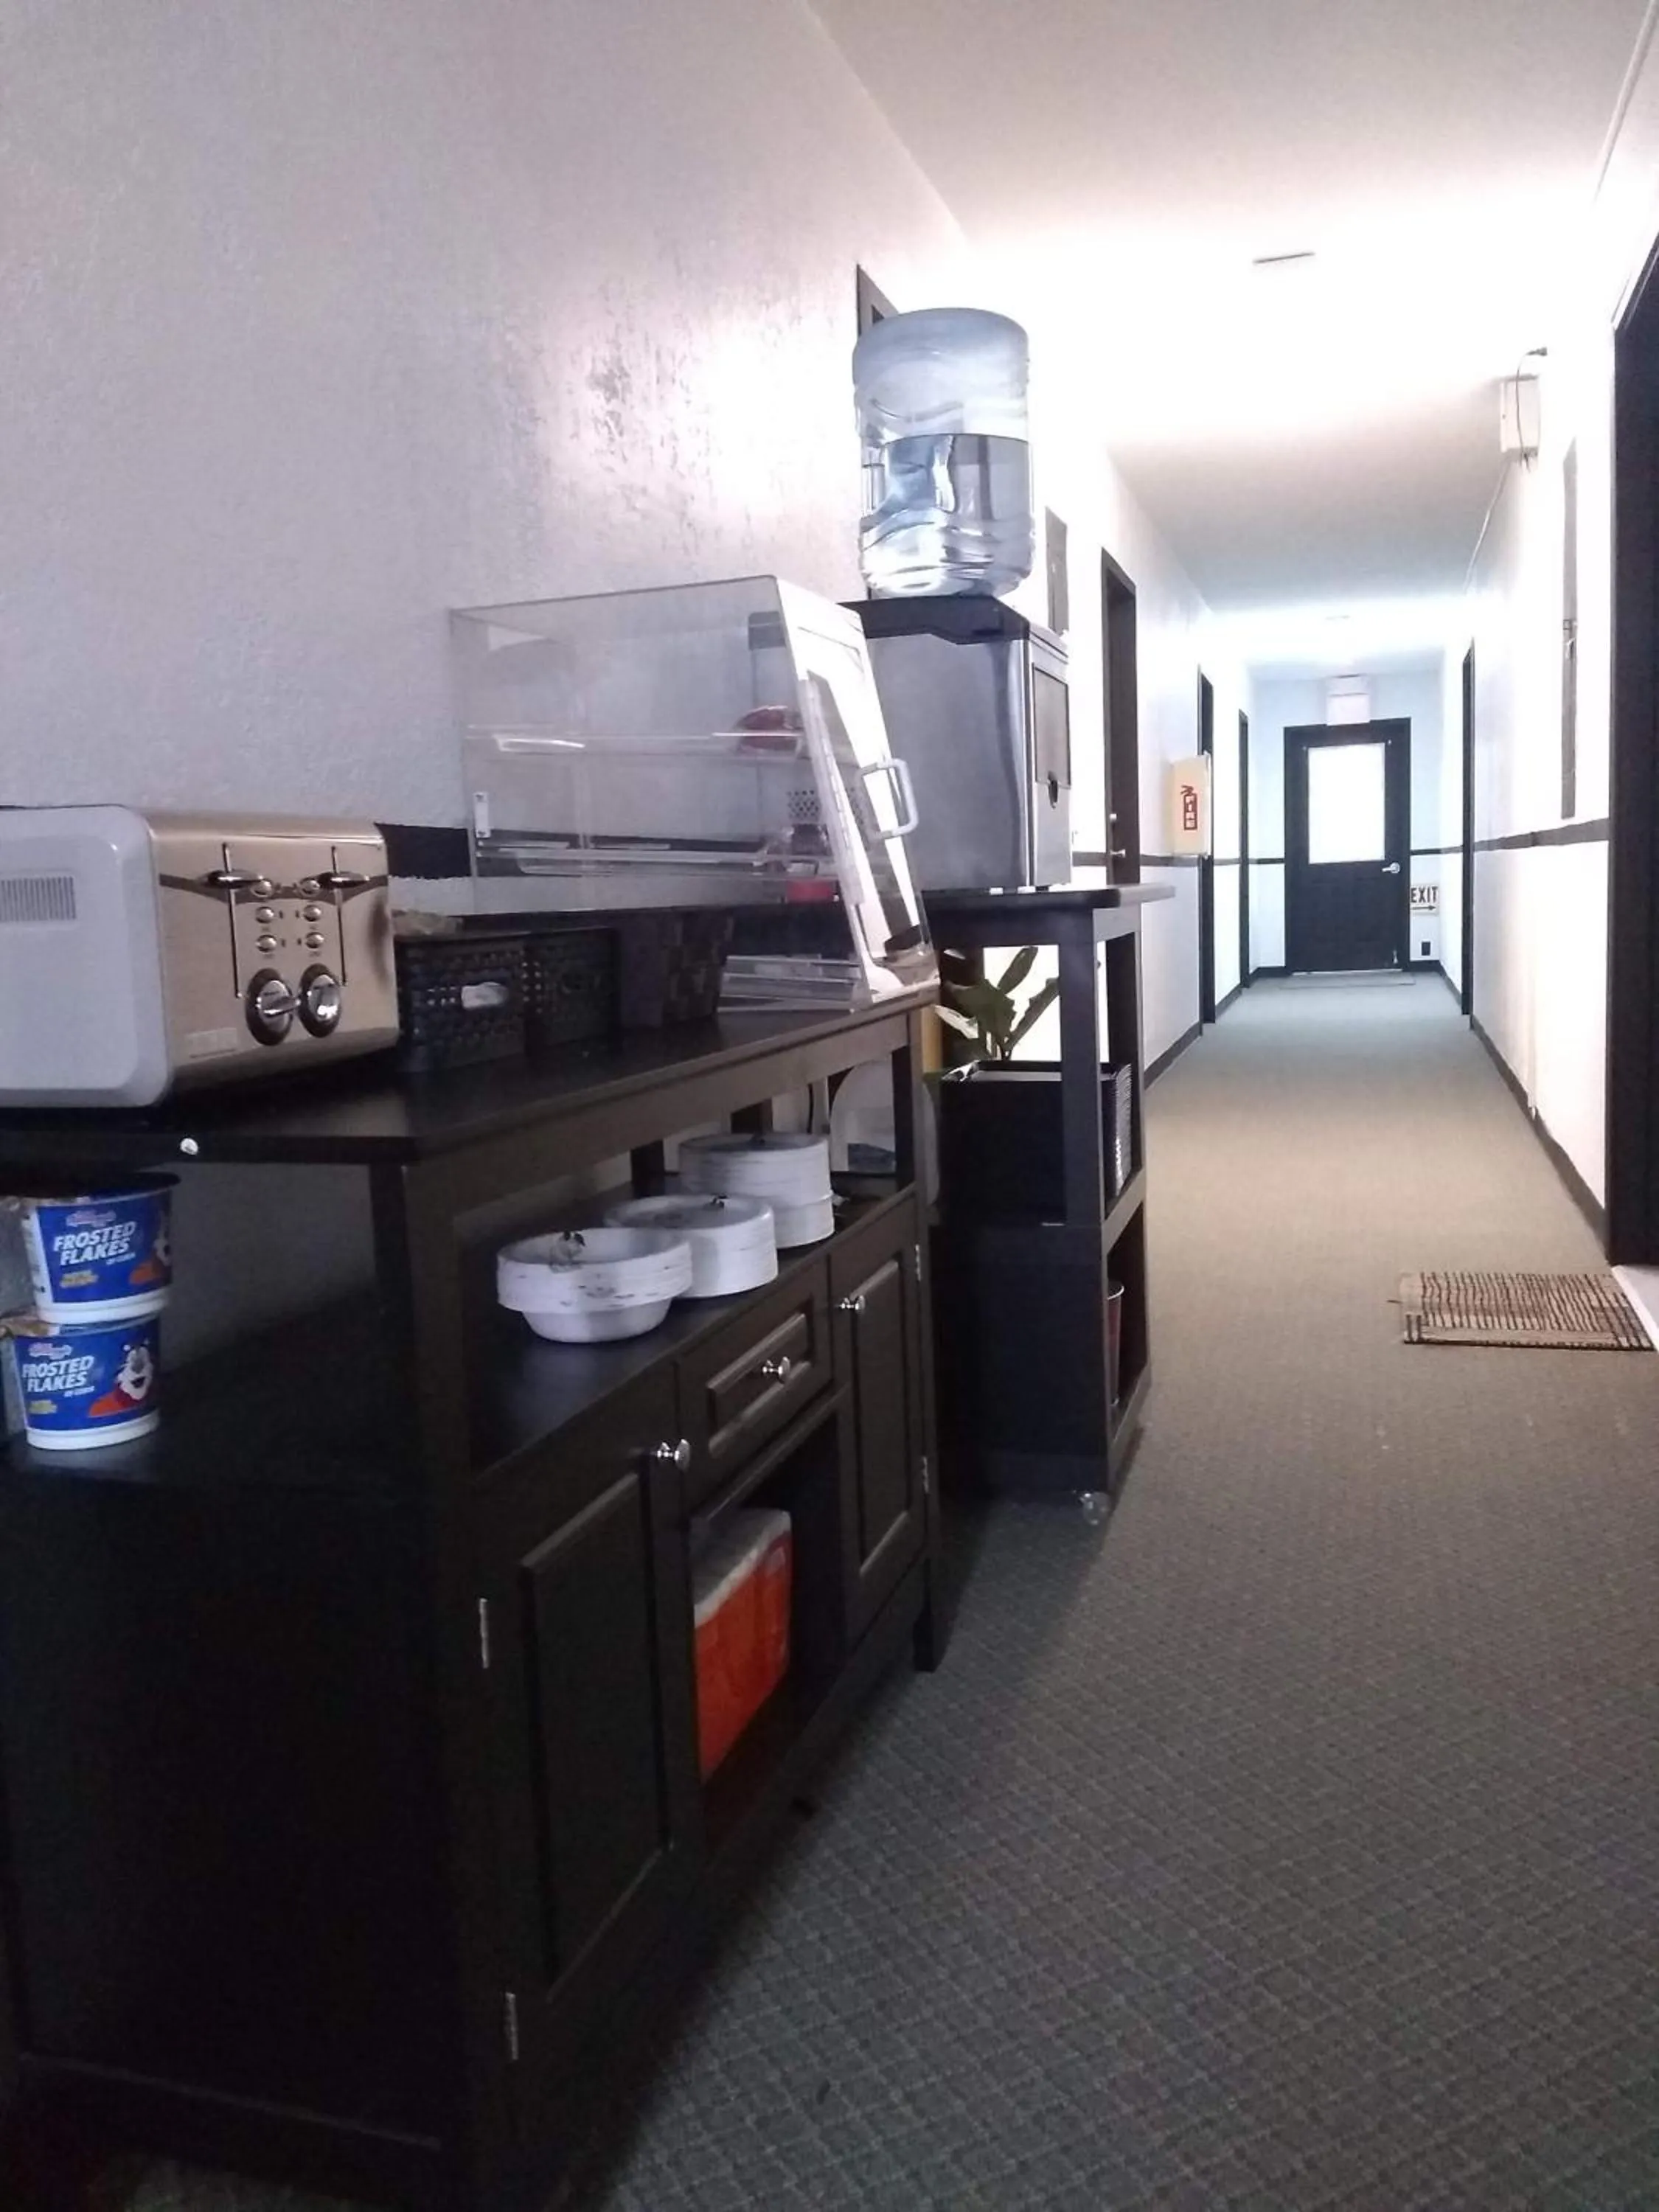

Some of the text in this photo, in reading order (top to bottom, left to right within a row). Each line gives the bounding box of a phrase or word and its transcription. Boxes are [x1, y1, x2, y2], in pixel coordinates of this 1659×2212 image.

[1411, 886, 1438, 903] EXIT
[53, 1221, 136, 1251] FROSTED
[60, 1237, 130, 1265] FLAKES
[22, 1355, 95, 1378] FROSTED
[27, 1371, 88, 1393] FLAKES
